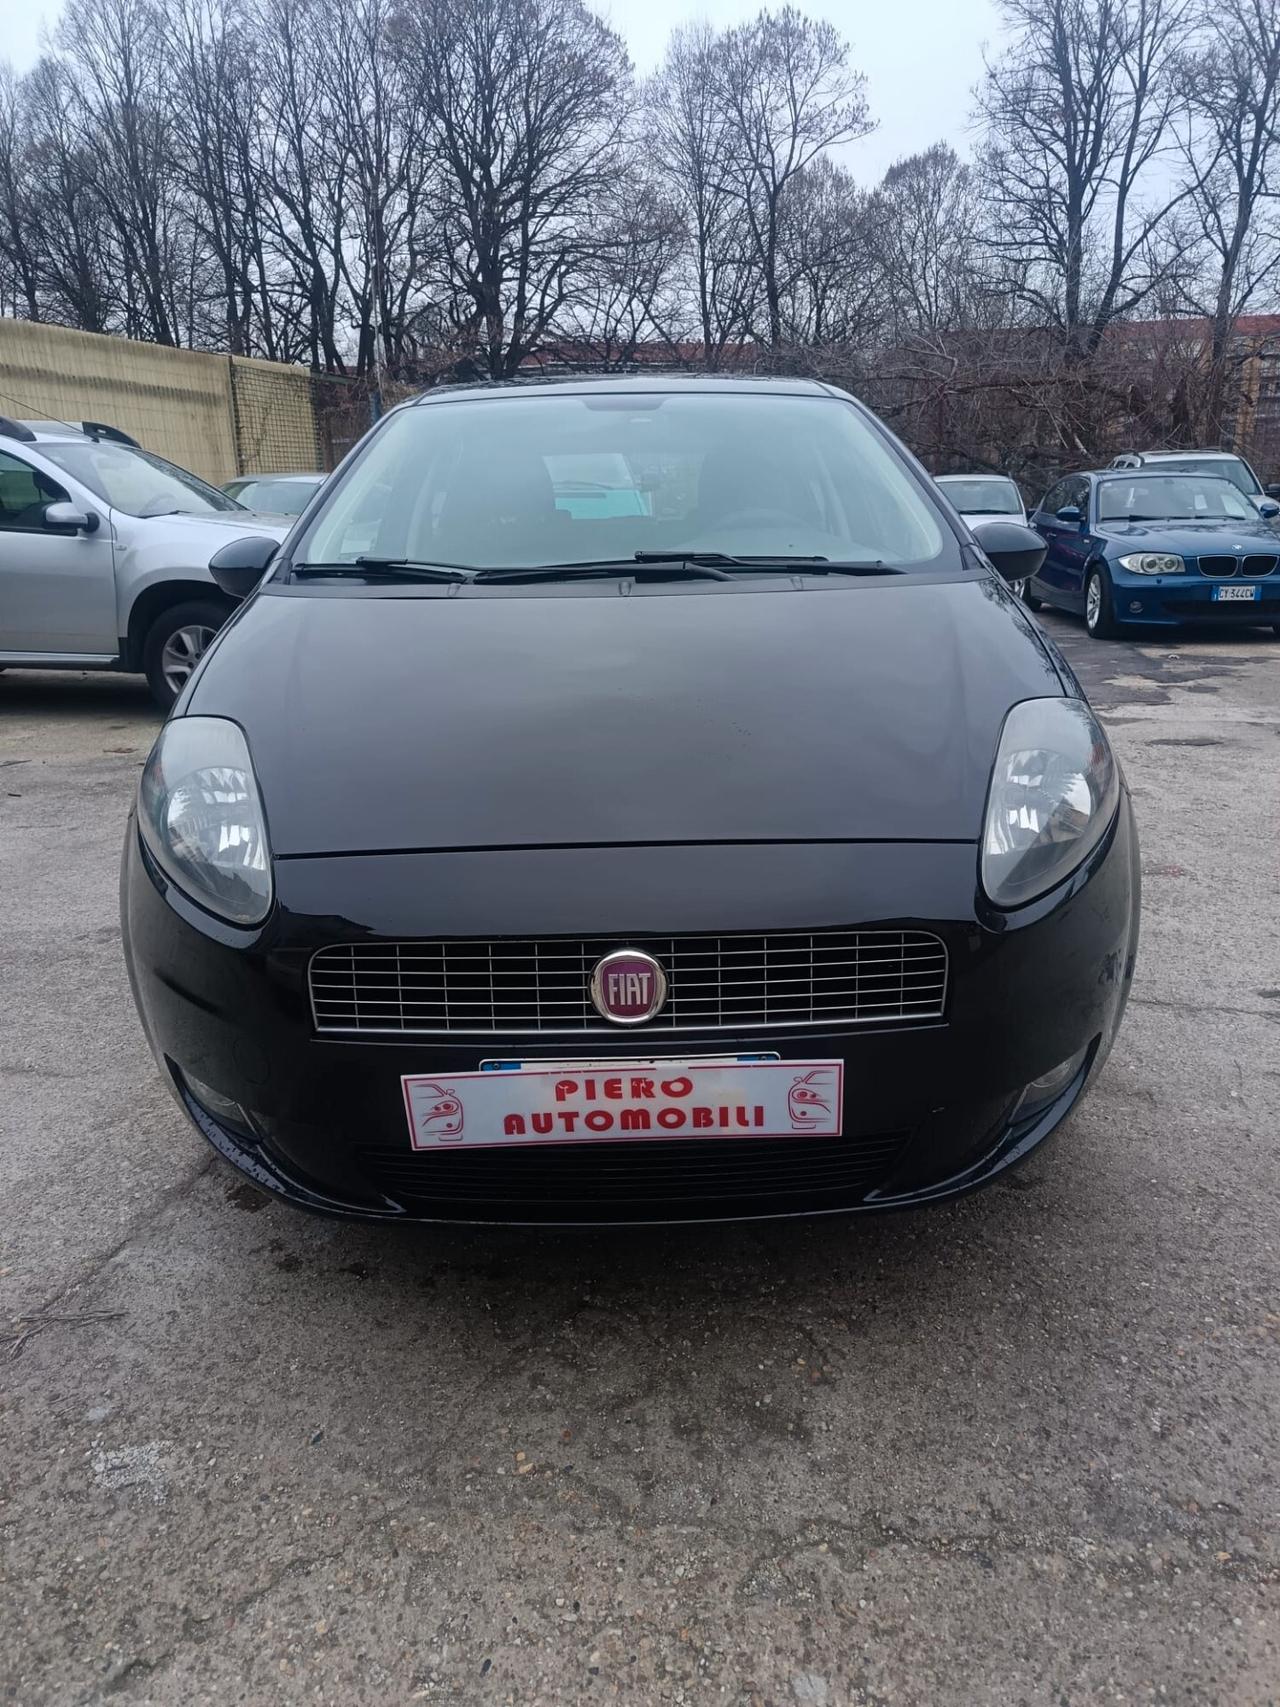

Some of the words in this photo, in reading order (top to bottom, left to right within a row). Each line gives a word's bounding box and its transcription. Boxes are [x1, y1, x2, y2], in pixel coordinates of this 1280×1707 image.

[608, 973, 651, 1006] FIAT
[555, 1077, 693, 1102] PIERO
[503, 1106, 764, 1135] AUTOMOBILI
